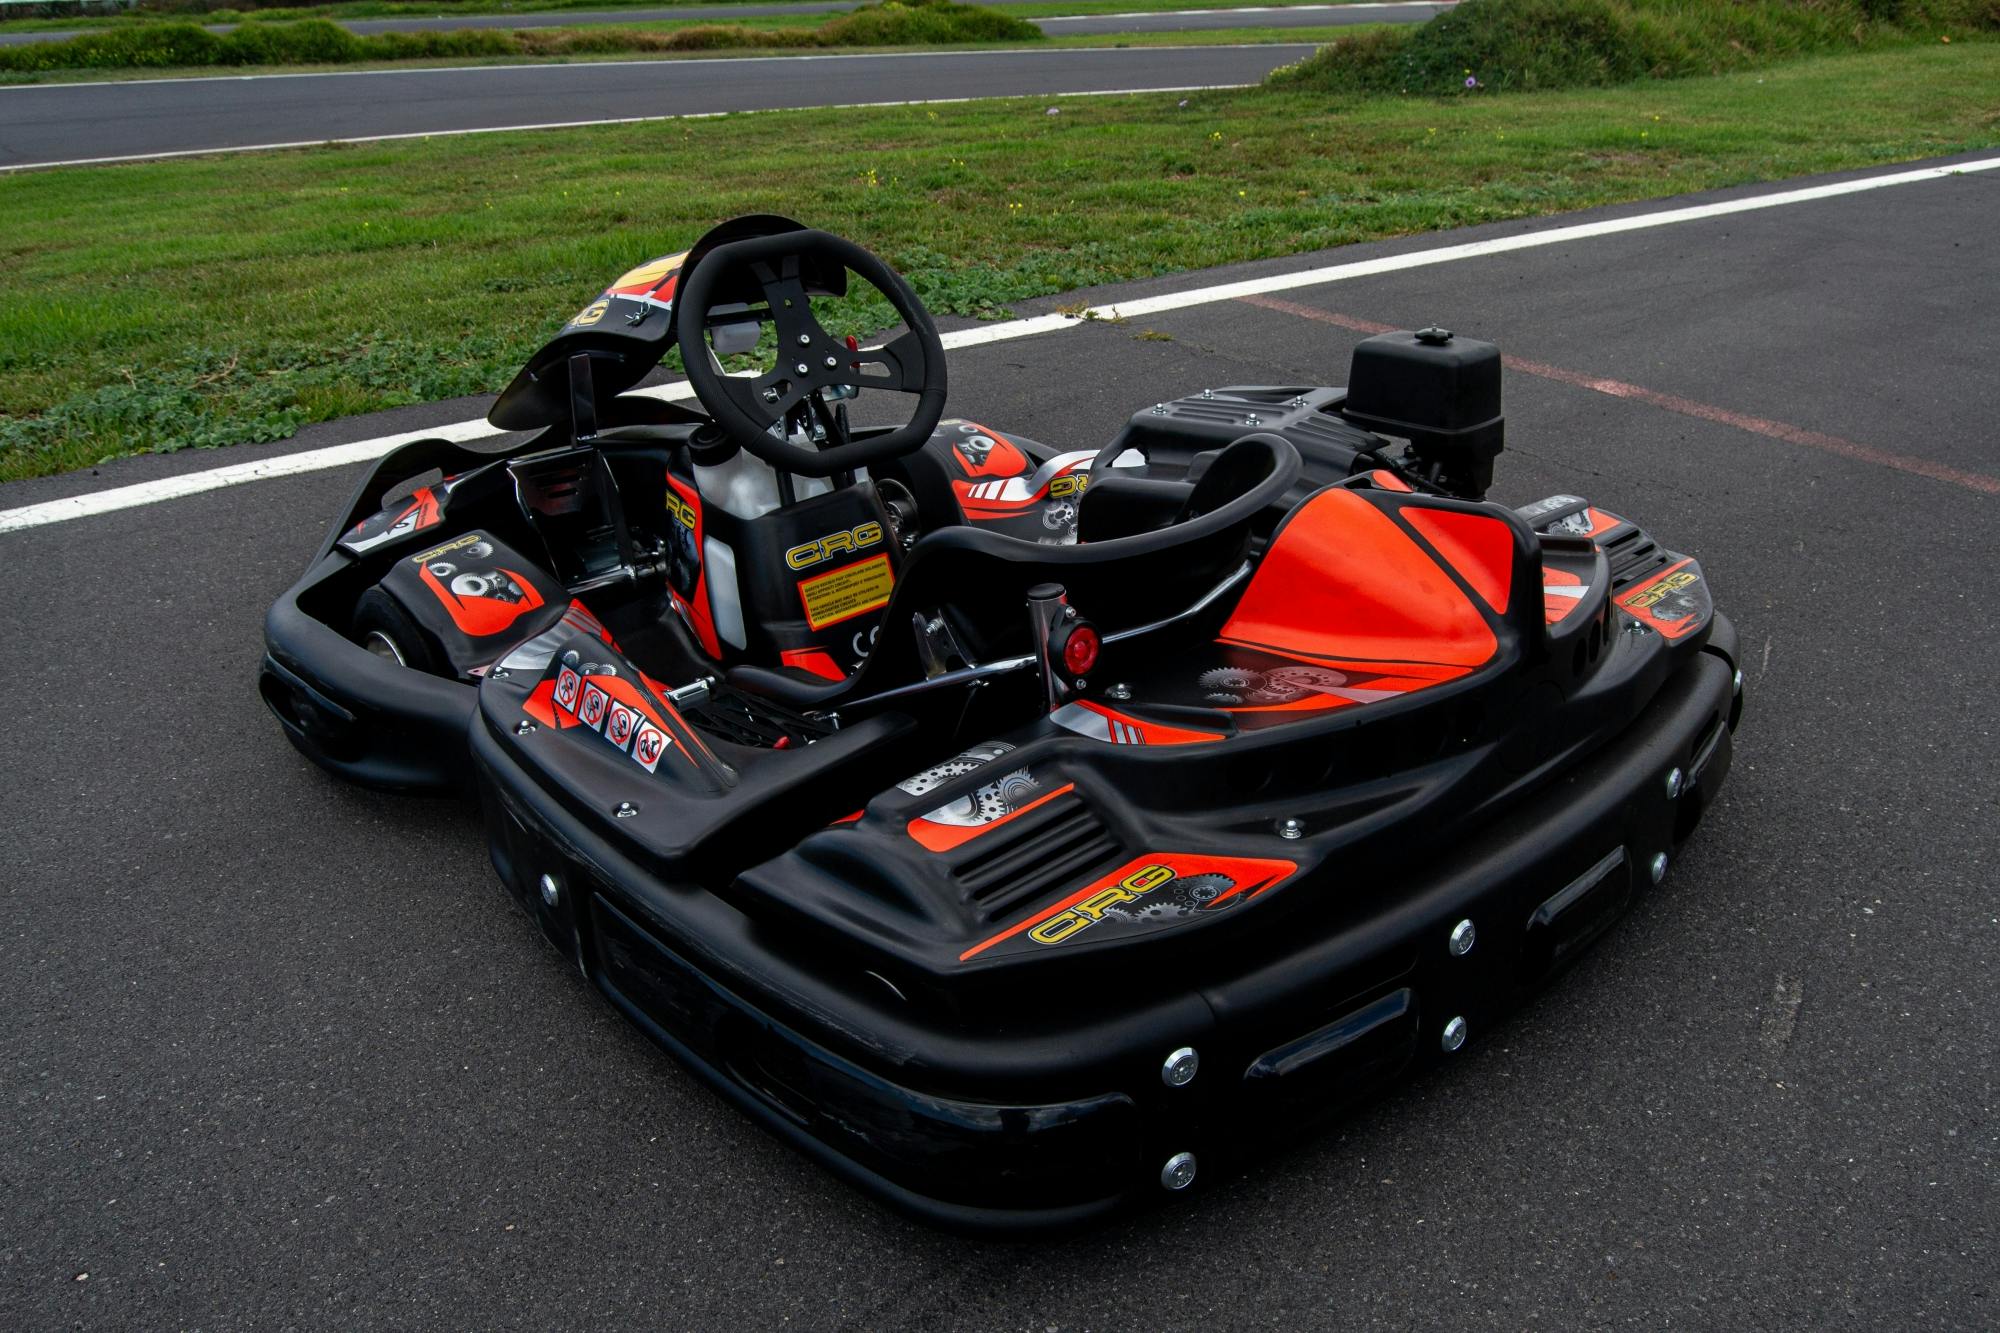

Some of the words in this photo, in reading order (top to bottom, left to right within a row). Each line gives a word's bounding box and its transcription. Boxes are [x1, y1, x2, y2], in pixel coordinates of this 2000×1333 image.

[786, 521, 884, 570] CRG
[1624, 572, 1700, 608] CRG
[1028, 864, 1177, 945] CRG
